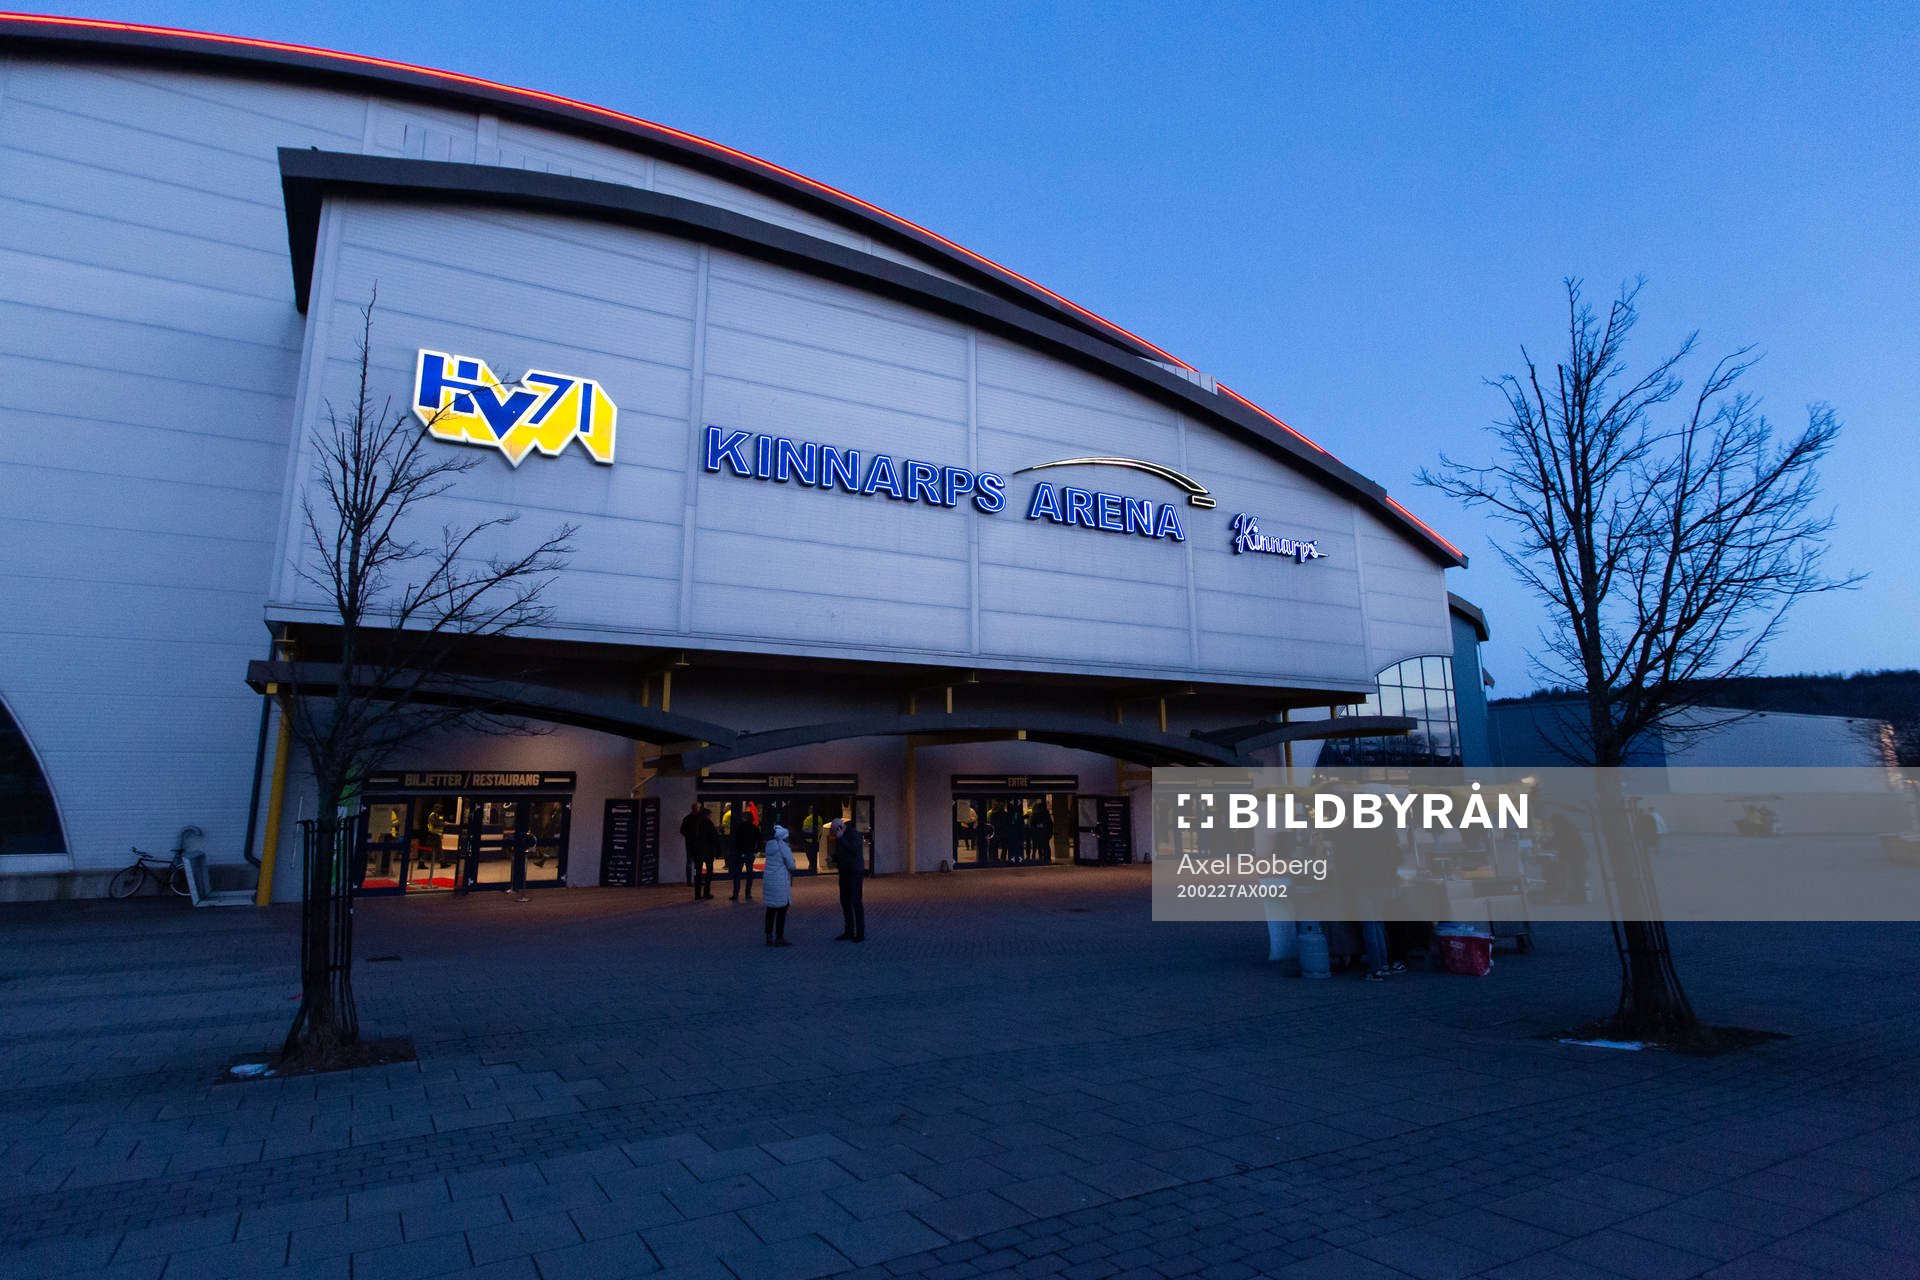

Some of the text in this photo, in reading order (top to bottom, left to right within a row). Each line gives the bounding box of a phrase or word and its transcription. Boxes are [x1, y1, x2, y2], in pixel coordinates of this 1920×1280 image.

[414, 349, 598, 444] HV71
[705, 426, 1185, 541] KINNARPS ARENA
[1232, 512, 1328, 564] Kinnarps
[404, 773, 462, 787] BILJETTER
[472, 773, 541, 787] RESTAURANG
